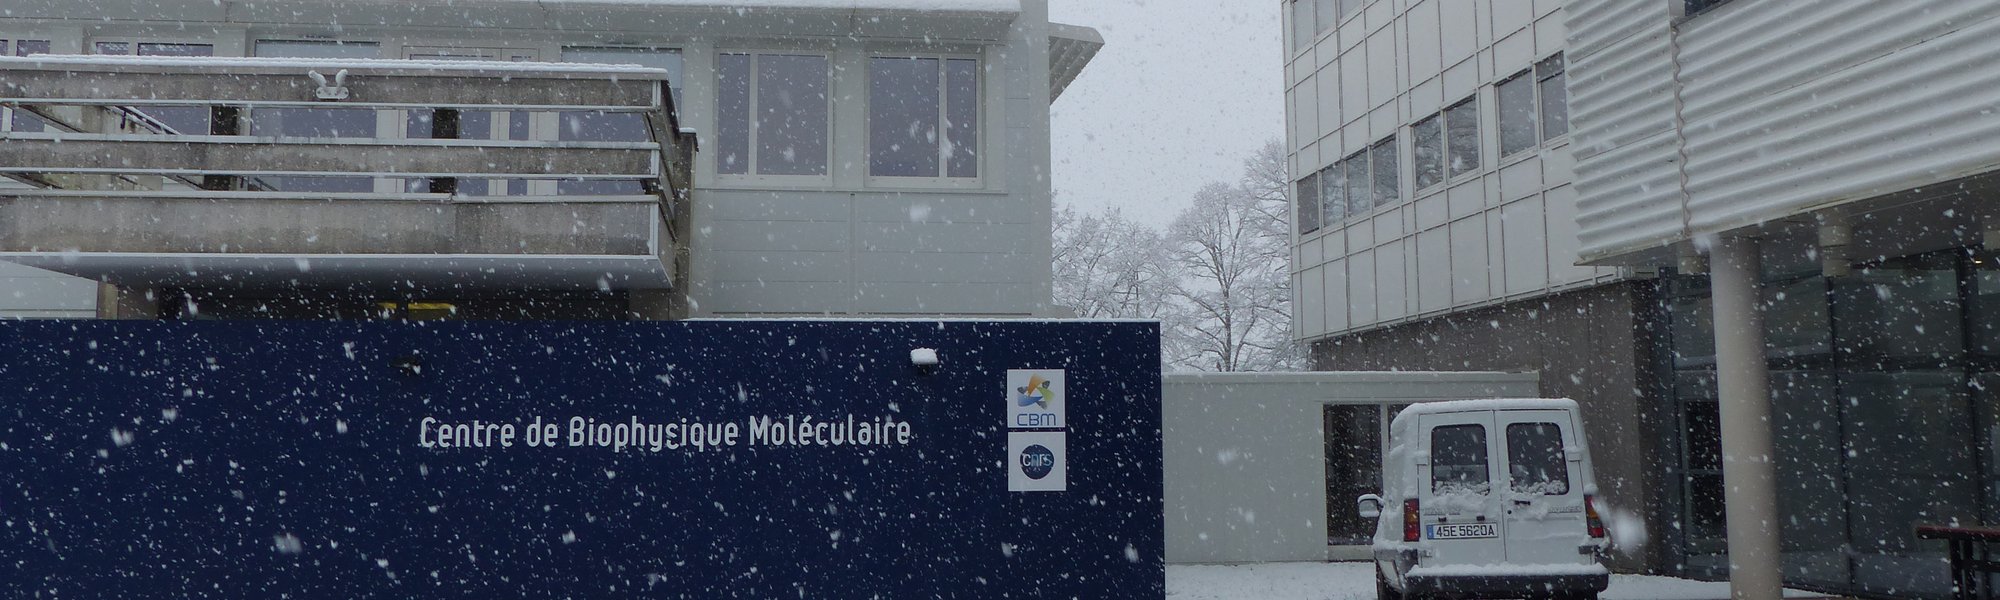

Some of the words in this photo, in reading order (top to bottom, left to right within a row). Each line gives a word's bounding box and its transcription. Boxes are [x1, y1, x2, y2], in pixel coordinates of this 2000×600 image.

[1017, 413, 1056, 426] CBM
[420, 416, 515, 448] Centre
[526, 415, 559, 448] de
[569, 415, 739, 453] Biophysique
[750, 413, 911, 446] Moléculaire
